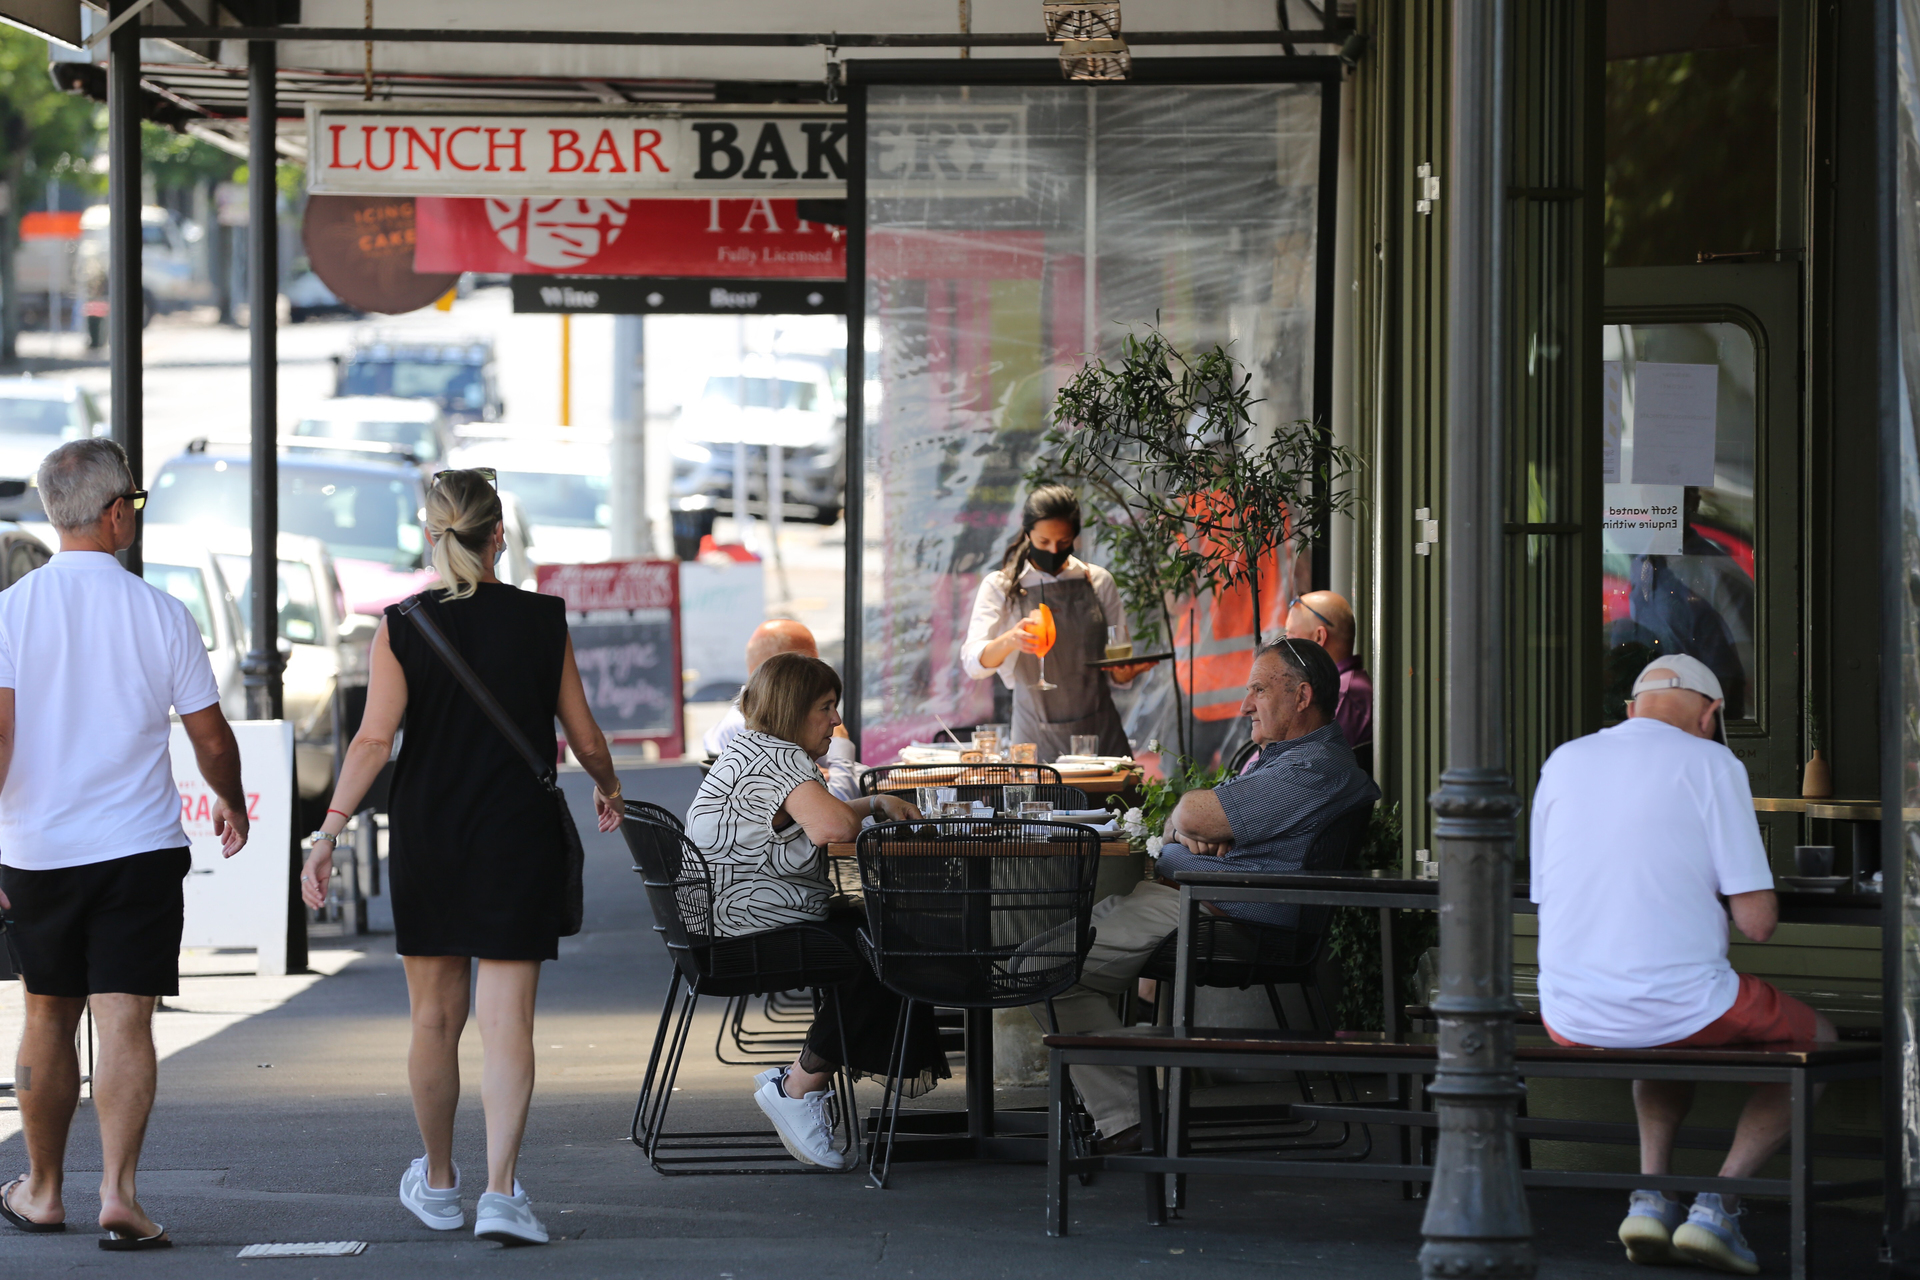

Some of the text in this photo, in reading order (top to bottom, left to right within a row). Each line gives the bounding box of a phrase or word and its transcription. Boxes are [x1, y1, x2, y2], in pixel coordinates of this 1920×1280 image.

[328, 124, 527, 172] LUNCH
[548, 128, 671, 173] BAR
[354, 202, 413, 224] ICING
[717, 245, 757, 266] Fully
[539, 286, 599, 308] Wine
[709, 286, 761, 308] Beer
